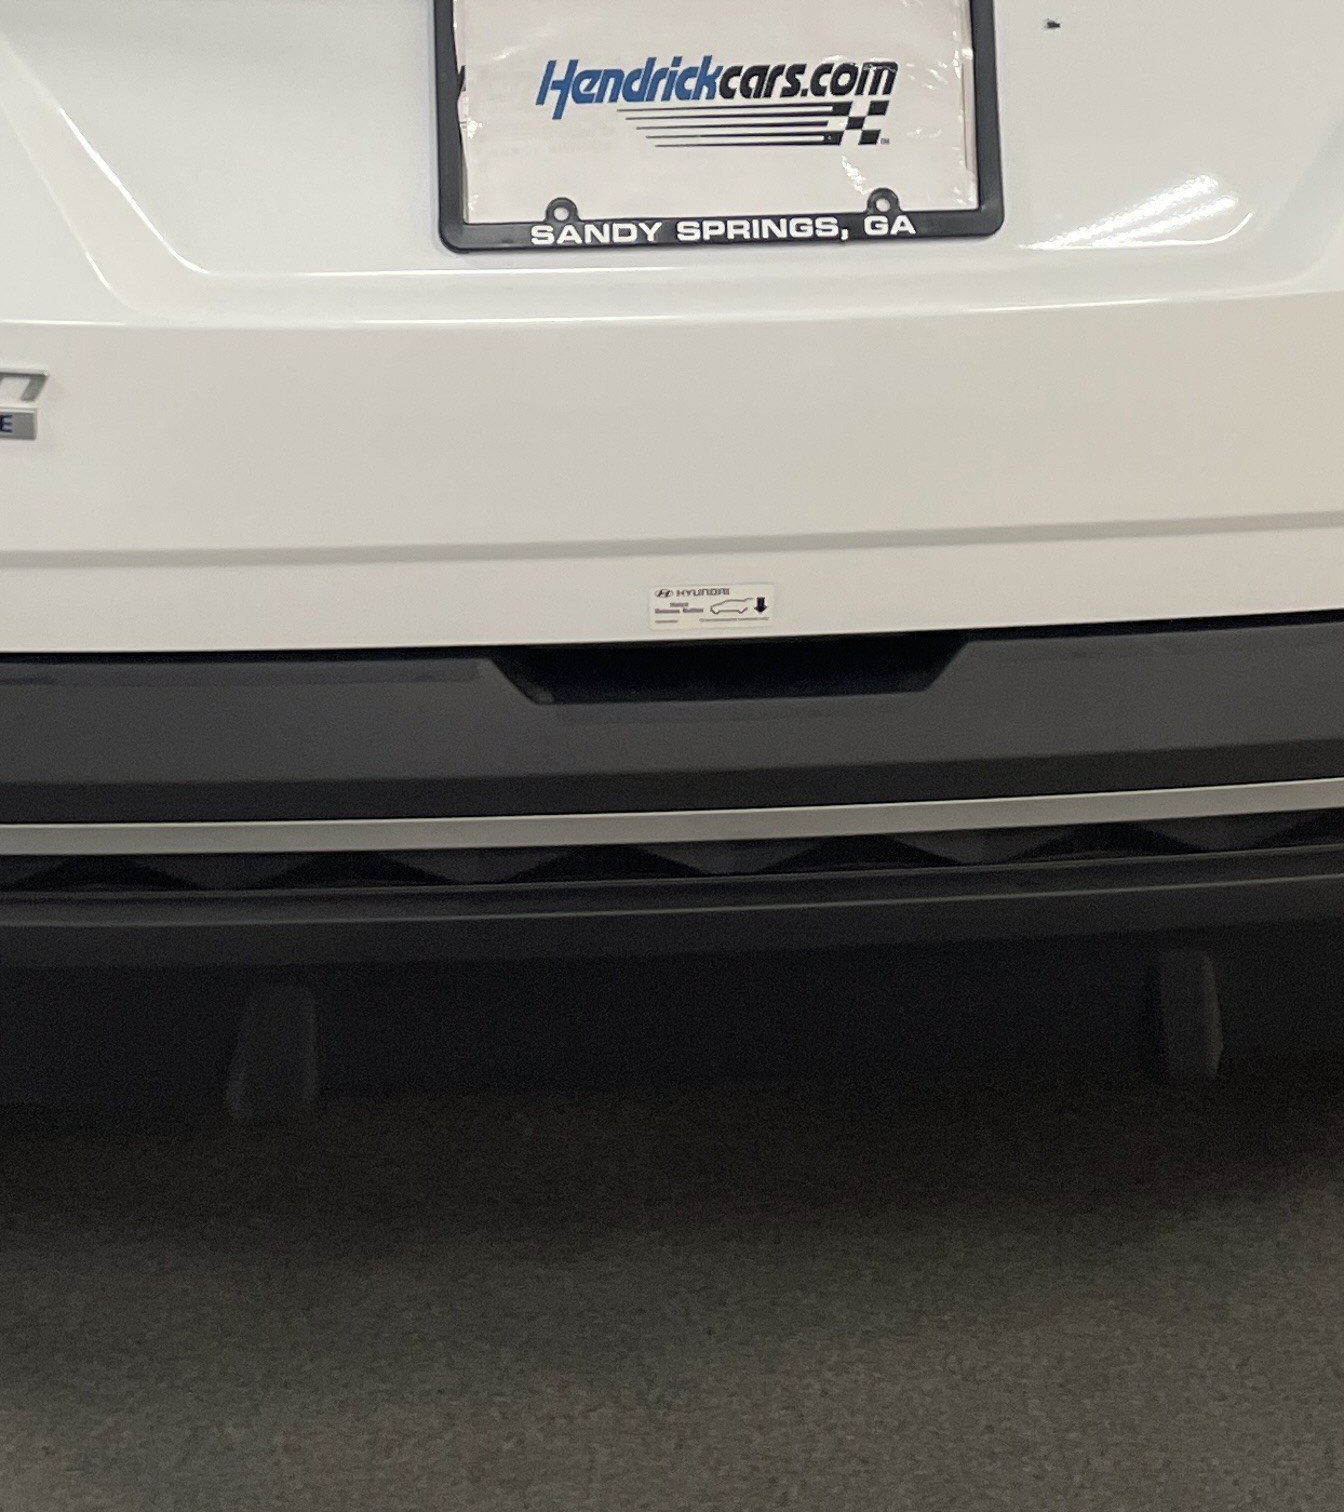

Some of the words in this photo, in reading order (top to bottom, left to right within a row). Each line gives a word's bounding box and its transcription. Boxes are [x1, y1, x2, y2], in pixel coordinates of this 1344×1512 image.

[535, 55, 898, 120] Hendrickcars.com
[531, 223, 662, 246] SANDY
[676, 216, 849, 242] SPRINGS,
[863, 215, 916, 237] GA
[676, 588, 730, 597] HYUNDAI
